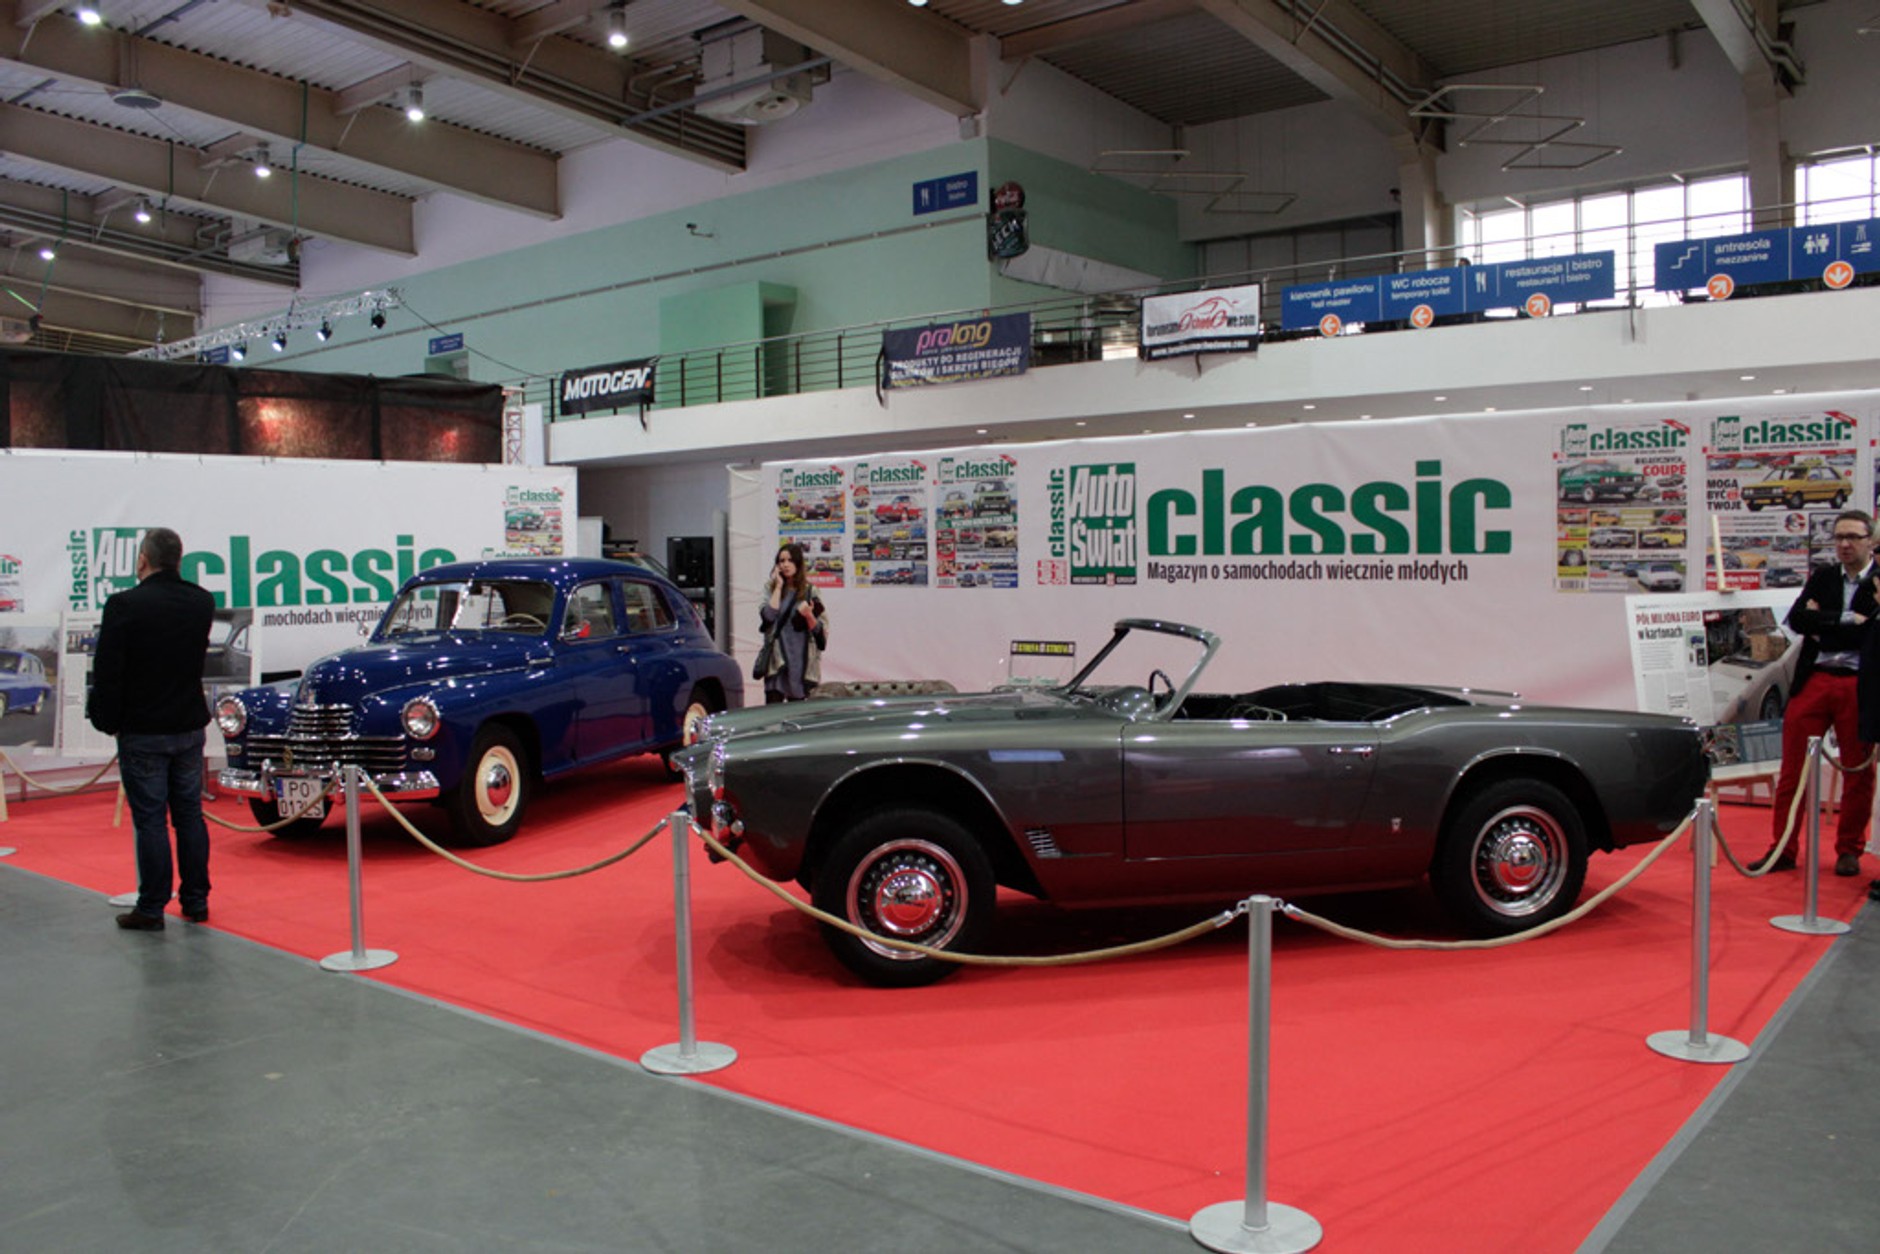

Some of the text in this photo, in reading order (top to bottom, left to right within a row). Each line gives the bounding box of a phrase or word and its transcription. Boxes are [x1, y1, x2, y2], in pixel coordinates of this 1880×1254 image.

[1714, 238, 1771, 254] antresola
[1715, 253, 1769, 265] mezzanine
[1505, 259, 1603, 279] restauracja bistro
[1566, 273, 1592, 283] bistro
[1391, 275, 1450, 290] WC robocze
[1290, 283, 1375, 301] kierownik pawilonu
[1391, 286, 1451, 301] temporary toilet
[1311, 297, 1352, 309] hall master
[915, 321, 992, 356] prolong
[940, 354, 954, 364] DO
[1589, 425, 1687, 451] classic
[1743, 417, 1852, 444] classic
[870, 465, 925, 482] classic
[955, 459, 1015, 479] classic
[793, 470, 842, 488] classic
[1070, 464, 1134, 518] Auto
[1047, 468, 1064, 557] classic
[1147, 460, 1512, 556] classic
[1707, 500, 1741, 511] TWOJE
[1071, 519, 1137, 568] Świat
[66, 530, 89, 612] classic
[1147, 560, 1468, 585] Magazyn o samochodach wiecznie młodych
[336, 605, 383, 623] wiecznie
[1645, 625, 1683, 639] kartonach
[288, 781, 310, 798] PO
